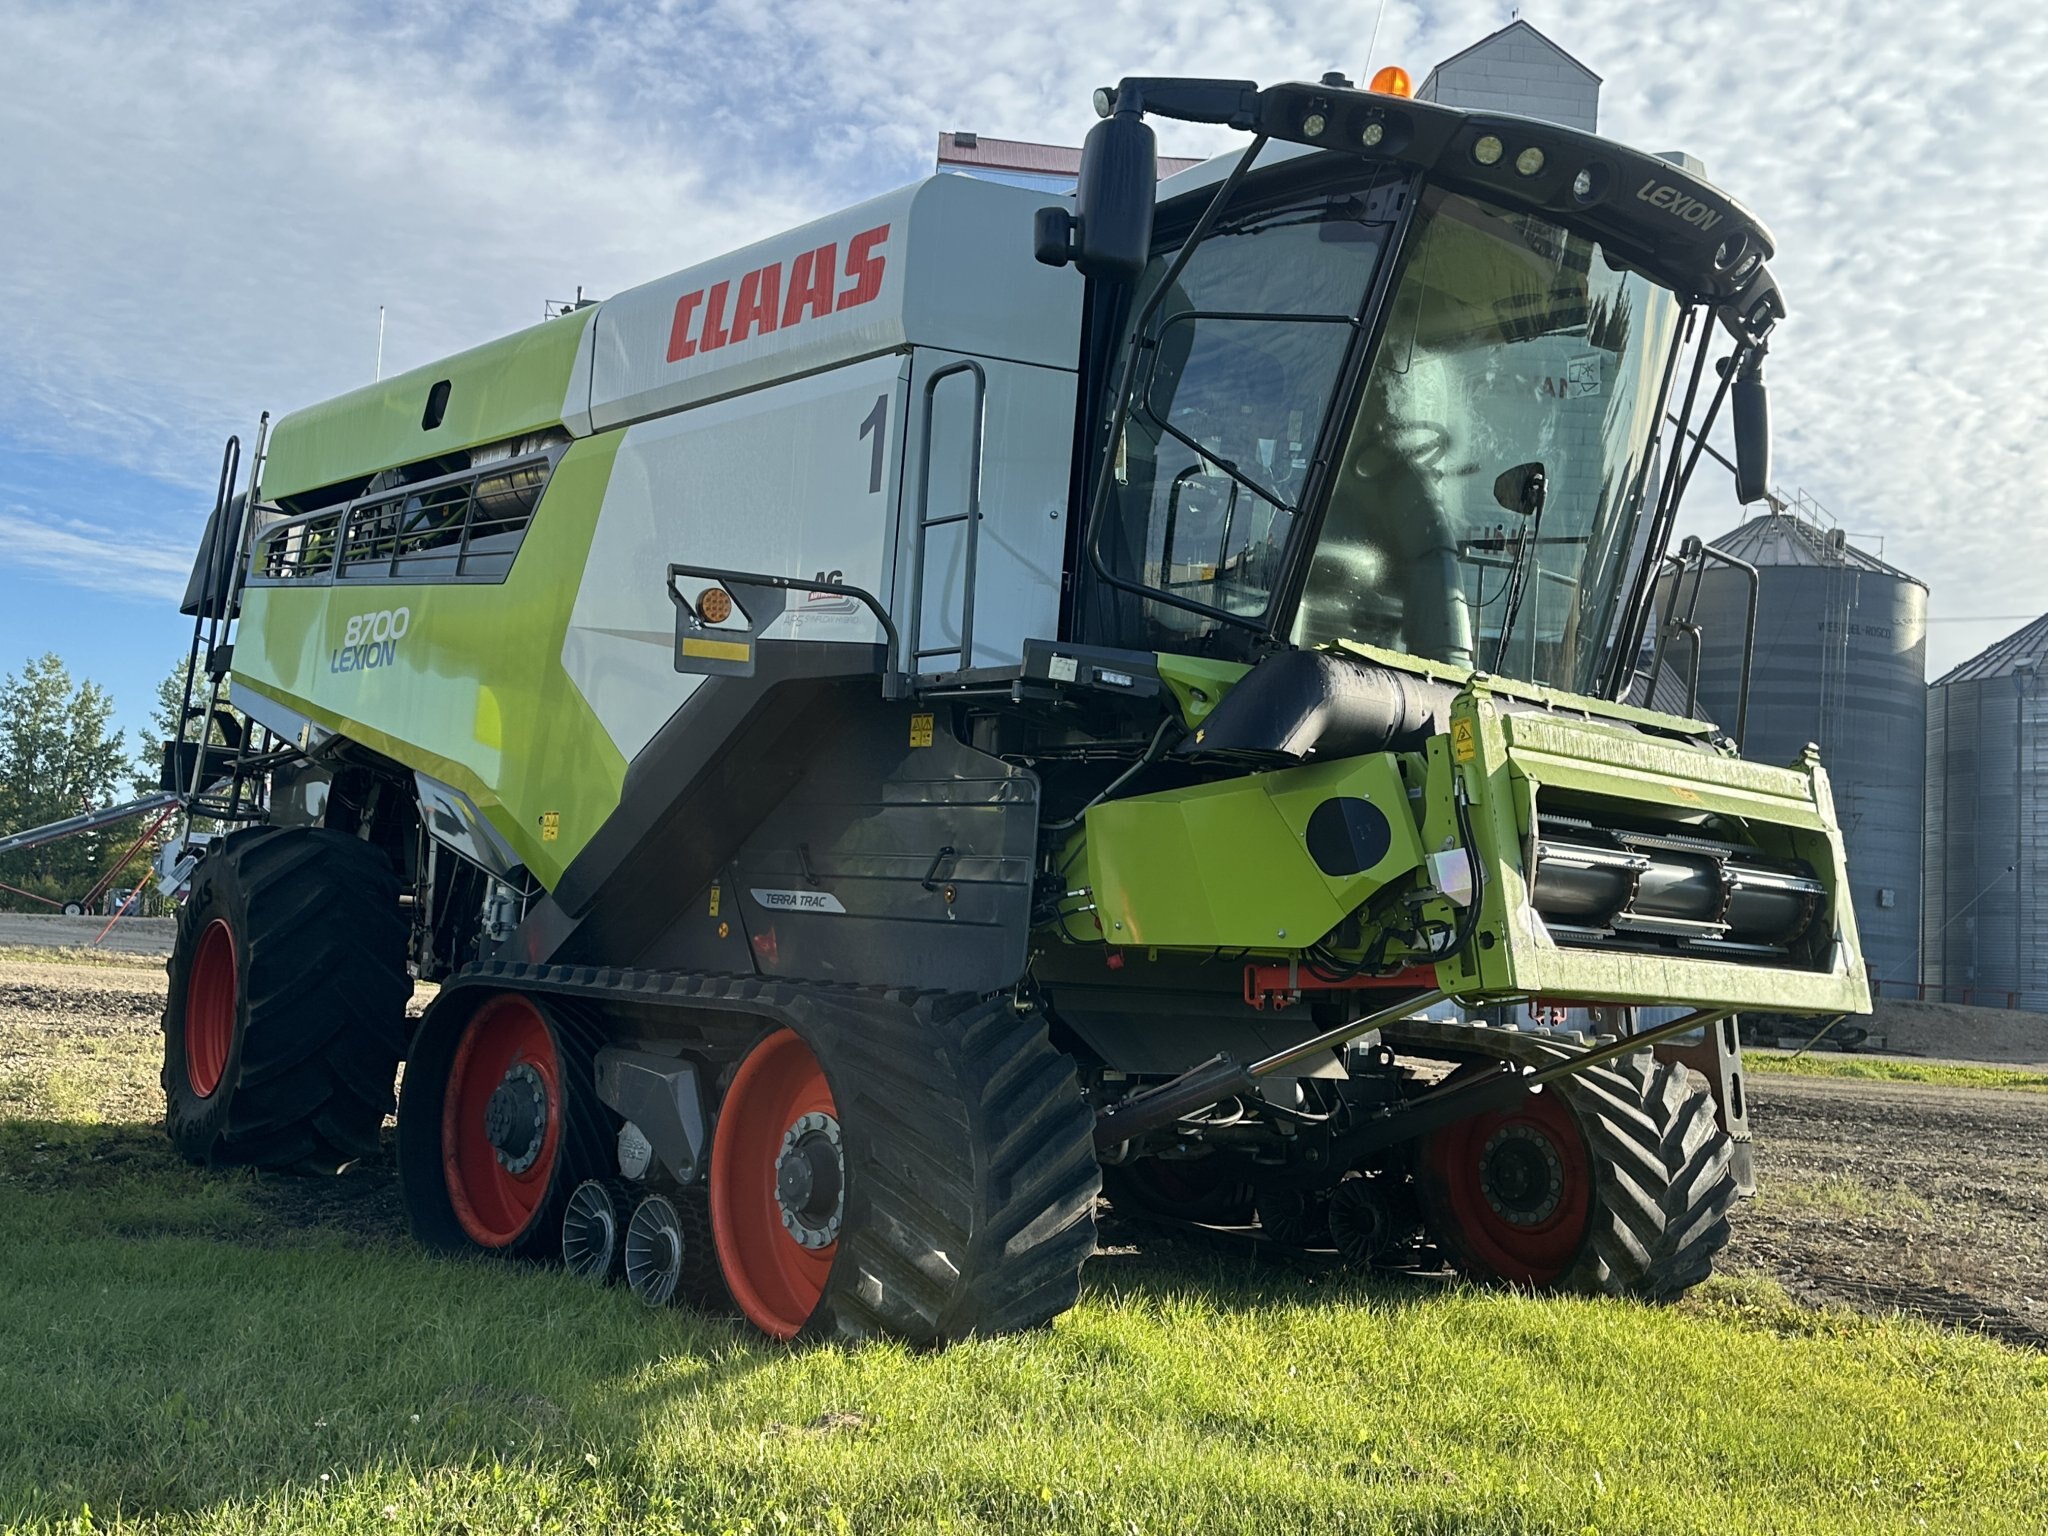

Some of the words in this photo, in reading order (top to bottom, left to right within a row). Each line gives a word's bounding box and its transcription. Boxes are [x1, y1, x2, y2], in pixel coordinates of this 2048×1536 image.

[1636, 179, 1724, 231] LEXION
[666, 223, 890, 363] CLAAS
[859, 393, 888, 494] 1
[344, 606, 410, 648] 8700
[1817, 621, 1891, 639] WESEL-ROSCO
[331, 639, 397, 674] LEXION
[766, 893, 797, 906] TERRA
[800, 895, 826, 908] TRAC
